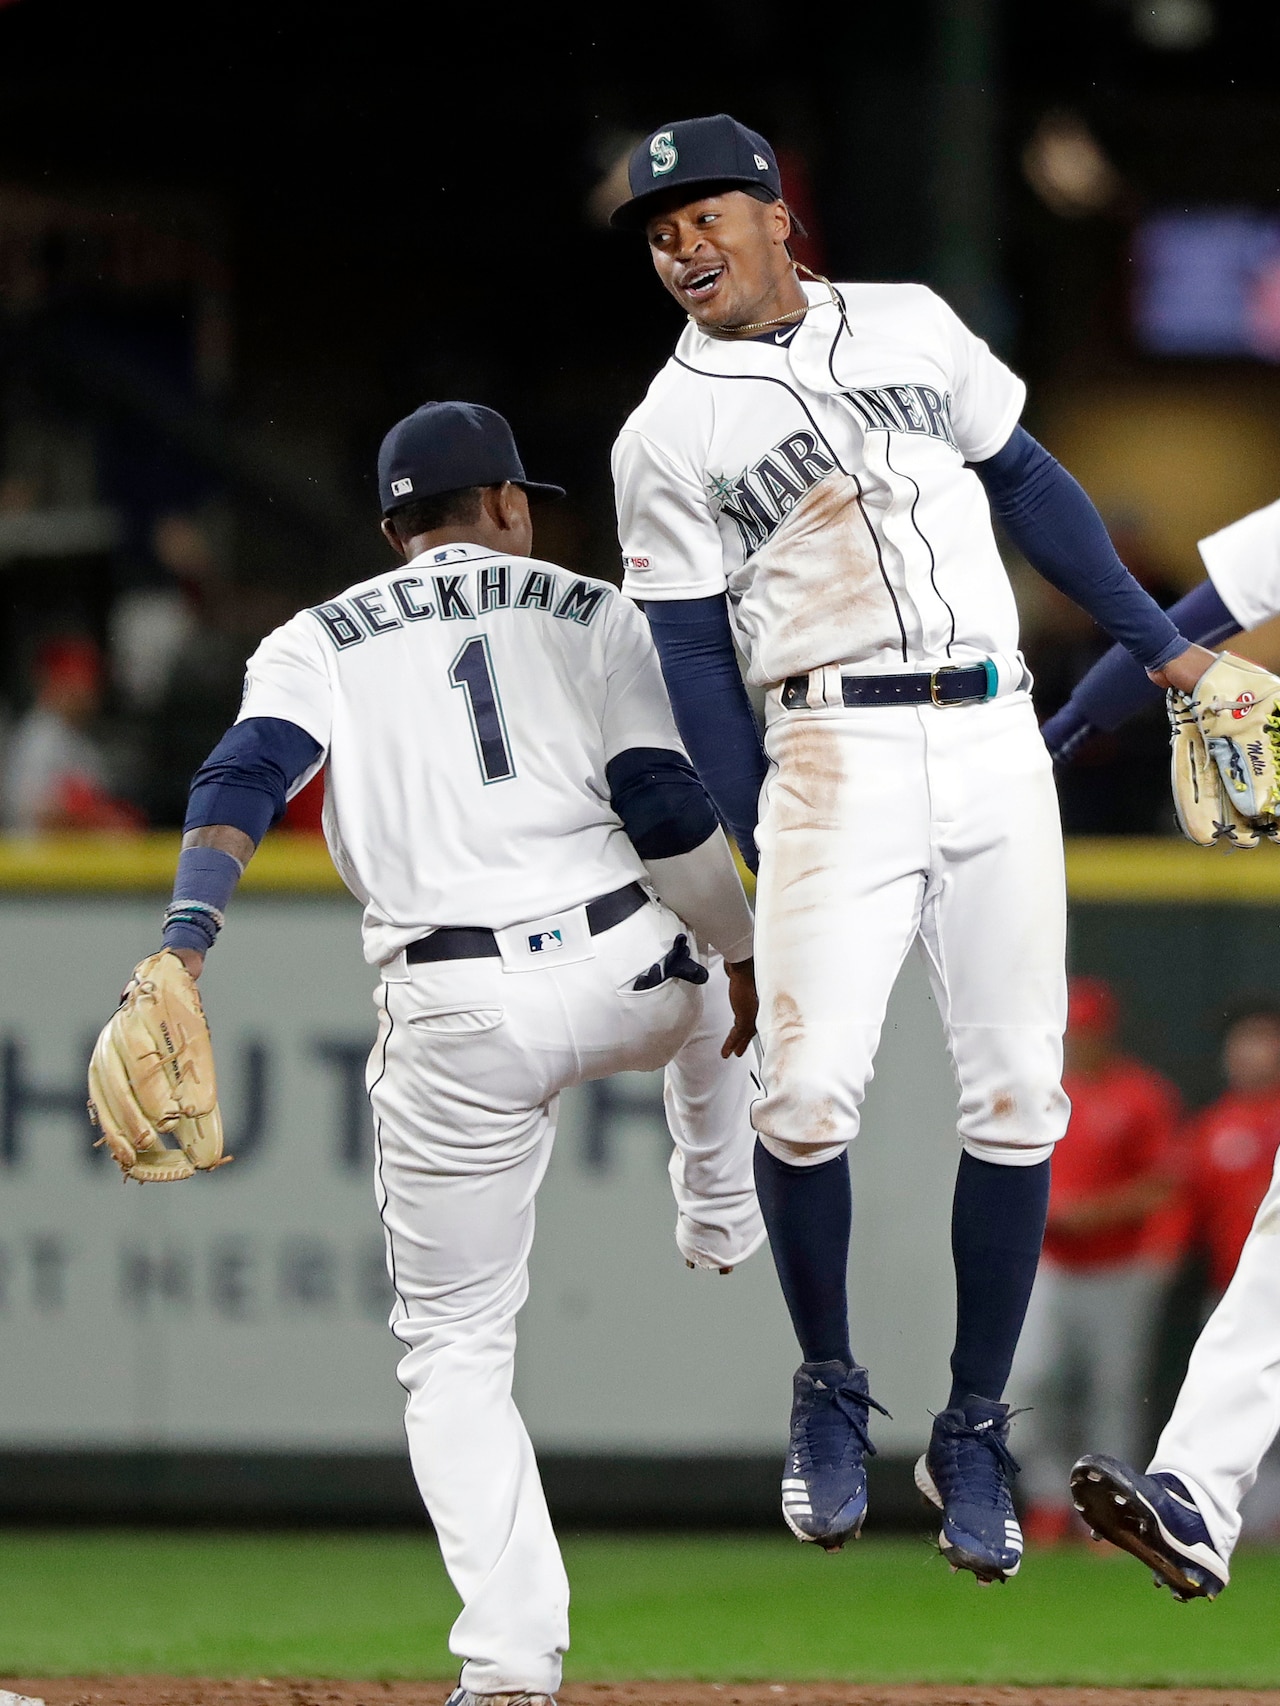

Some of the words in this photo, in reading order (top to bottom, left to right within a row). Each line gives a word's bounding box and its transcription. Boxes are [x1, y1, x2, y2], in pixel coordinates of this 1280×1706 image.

[649, 131, 678, 178] S
[306, 565, 613, 652] BECKHAM
[447, 632, 517, 786] 1
